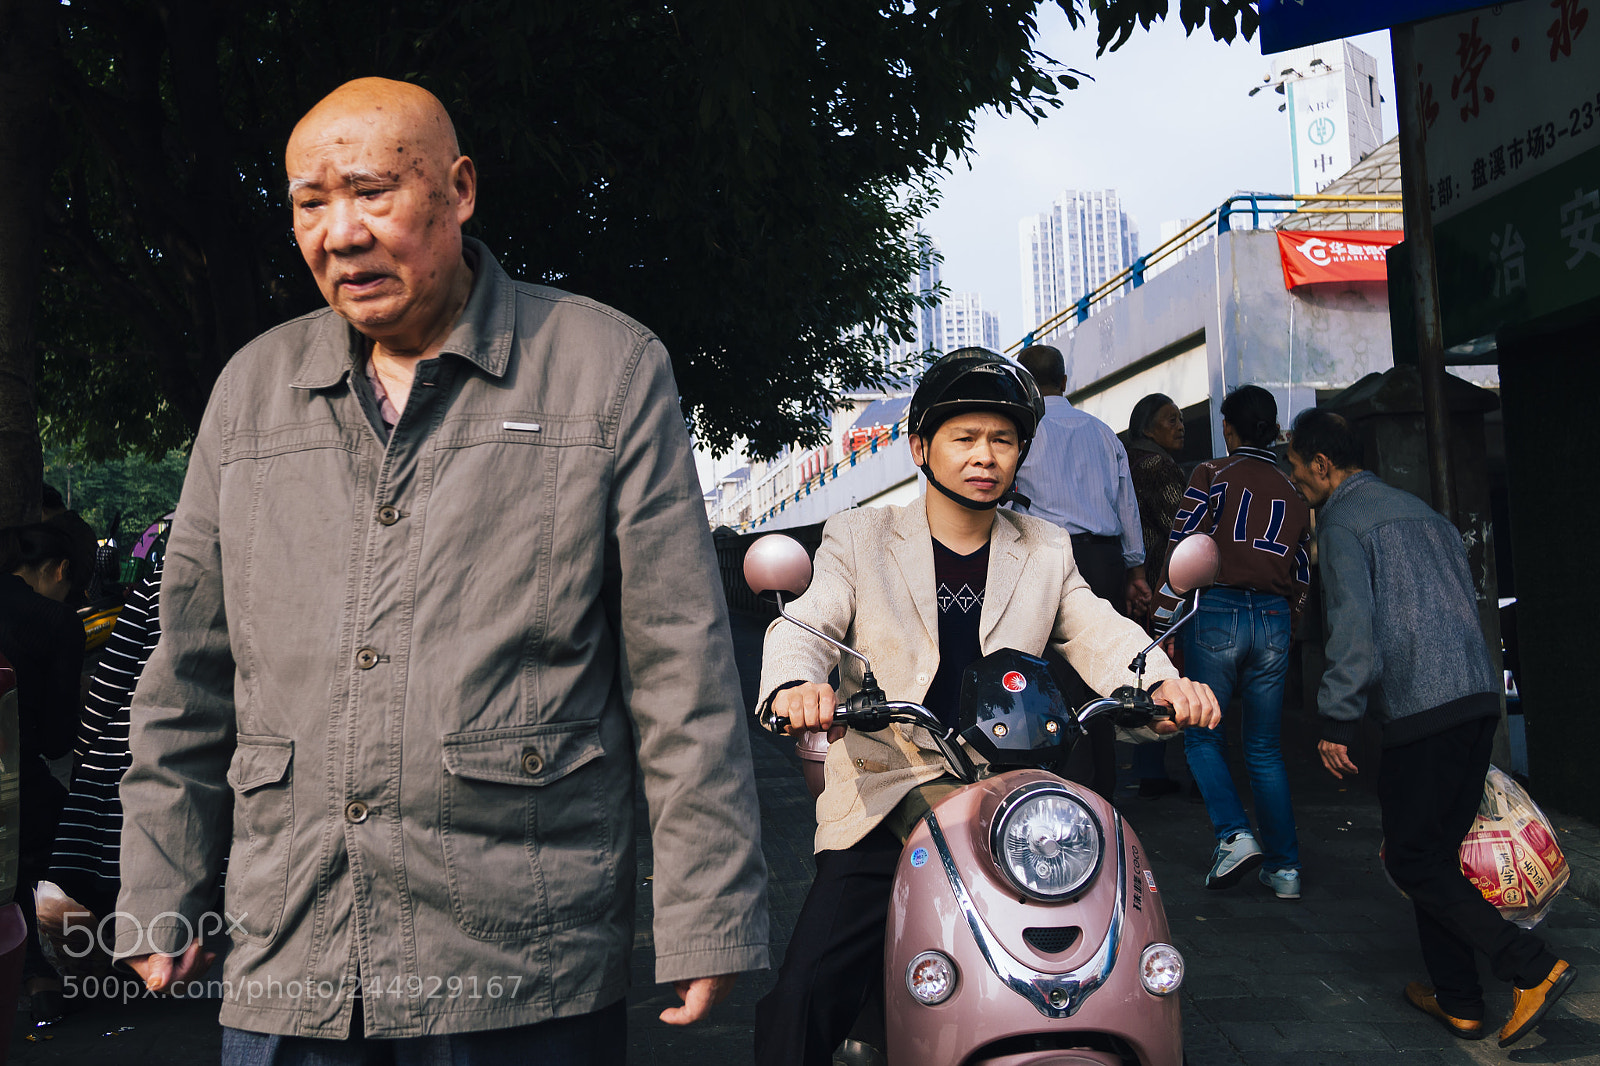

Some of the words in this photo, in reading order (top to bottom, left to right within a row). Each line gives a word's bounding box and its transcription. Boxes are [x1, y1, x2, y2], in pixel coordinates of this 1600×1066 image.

[1308, 100, 1334, 112] ABC
[1429, 91, 1600, 211] 部：盘溪市场3-23
